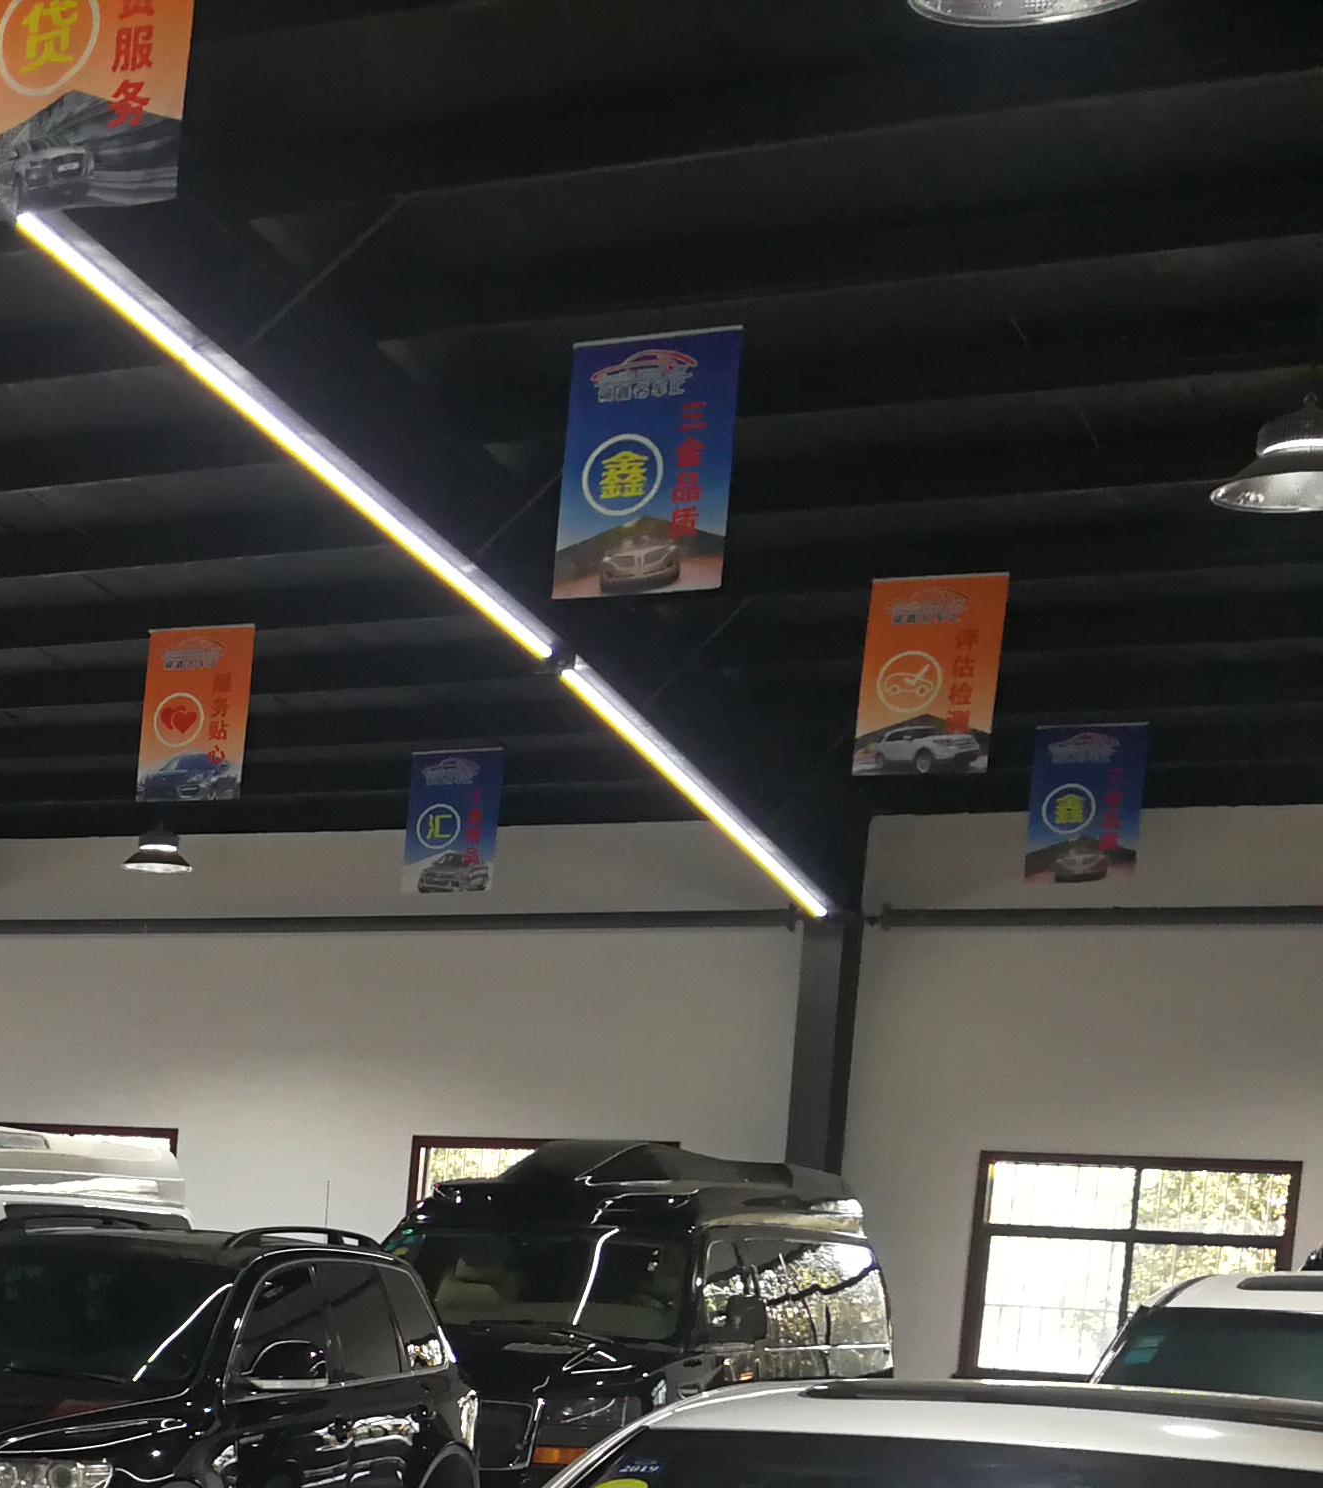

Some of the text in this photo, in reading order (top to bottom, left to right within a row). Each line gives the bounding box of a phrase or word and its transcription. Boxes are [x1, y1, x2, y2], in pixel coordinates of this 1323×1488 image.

[599, 450, 649, 500] 鑫
[668, 401, 708, 540] 三金品质
[946, 627, 980, 734] 评估检测
[206, 672, 232, 765] 服务贴心
[426, 814, 453, 840] 汇
[619, 1465, 660, 1473] 2019
